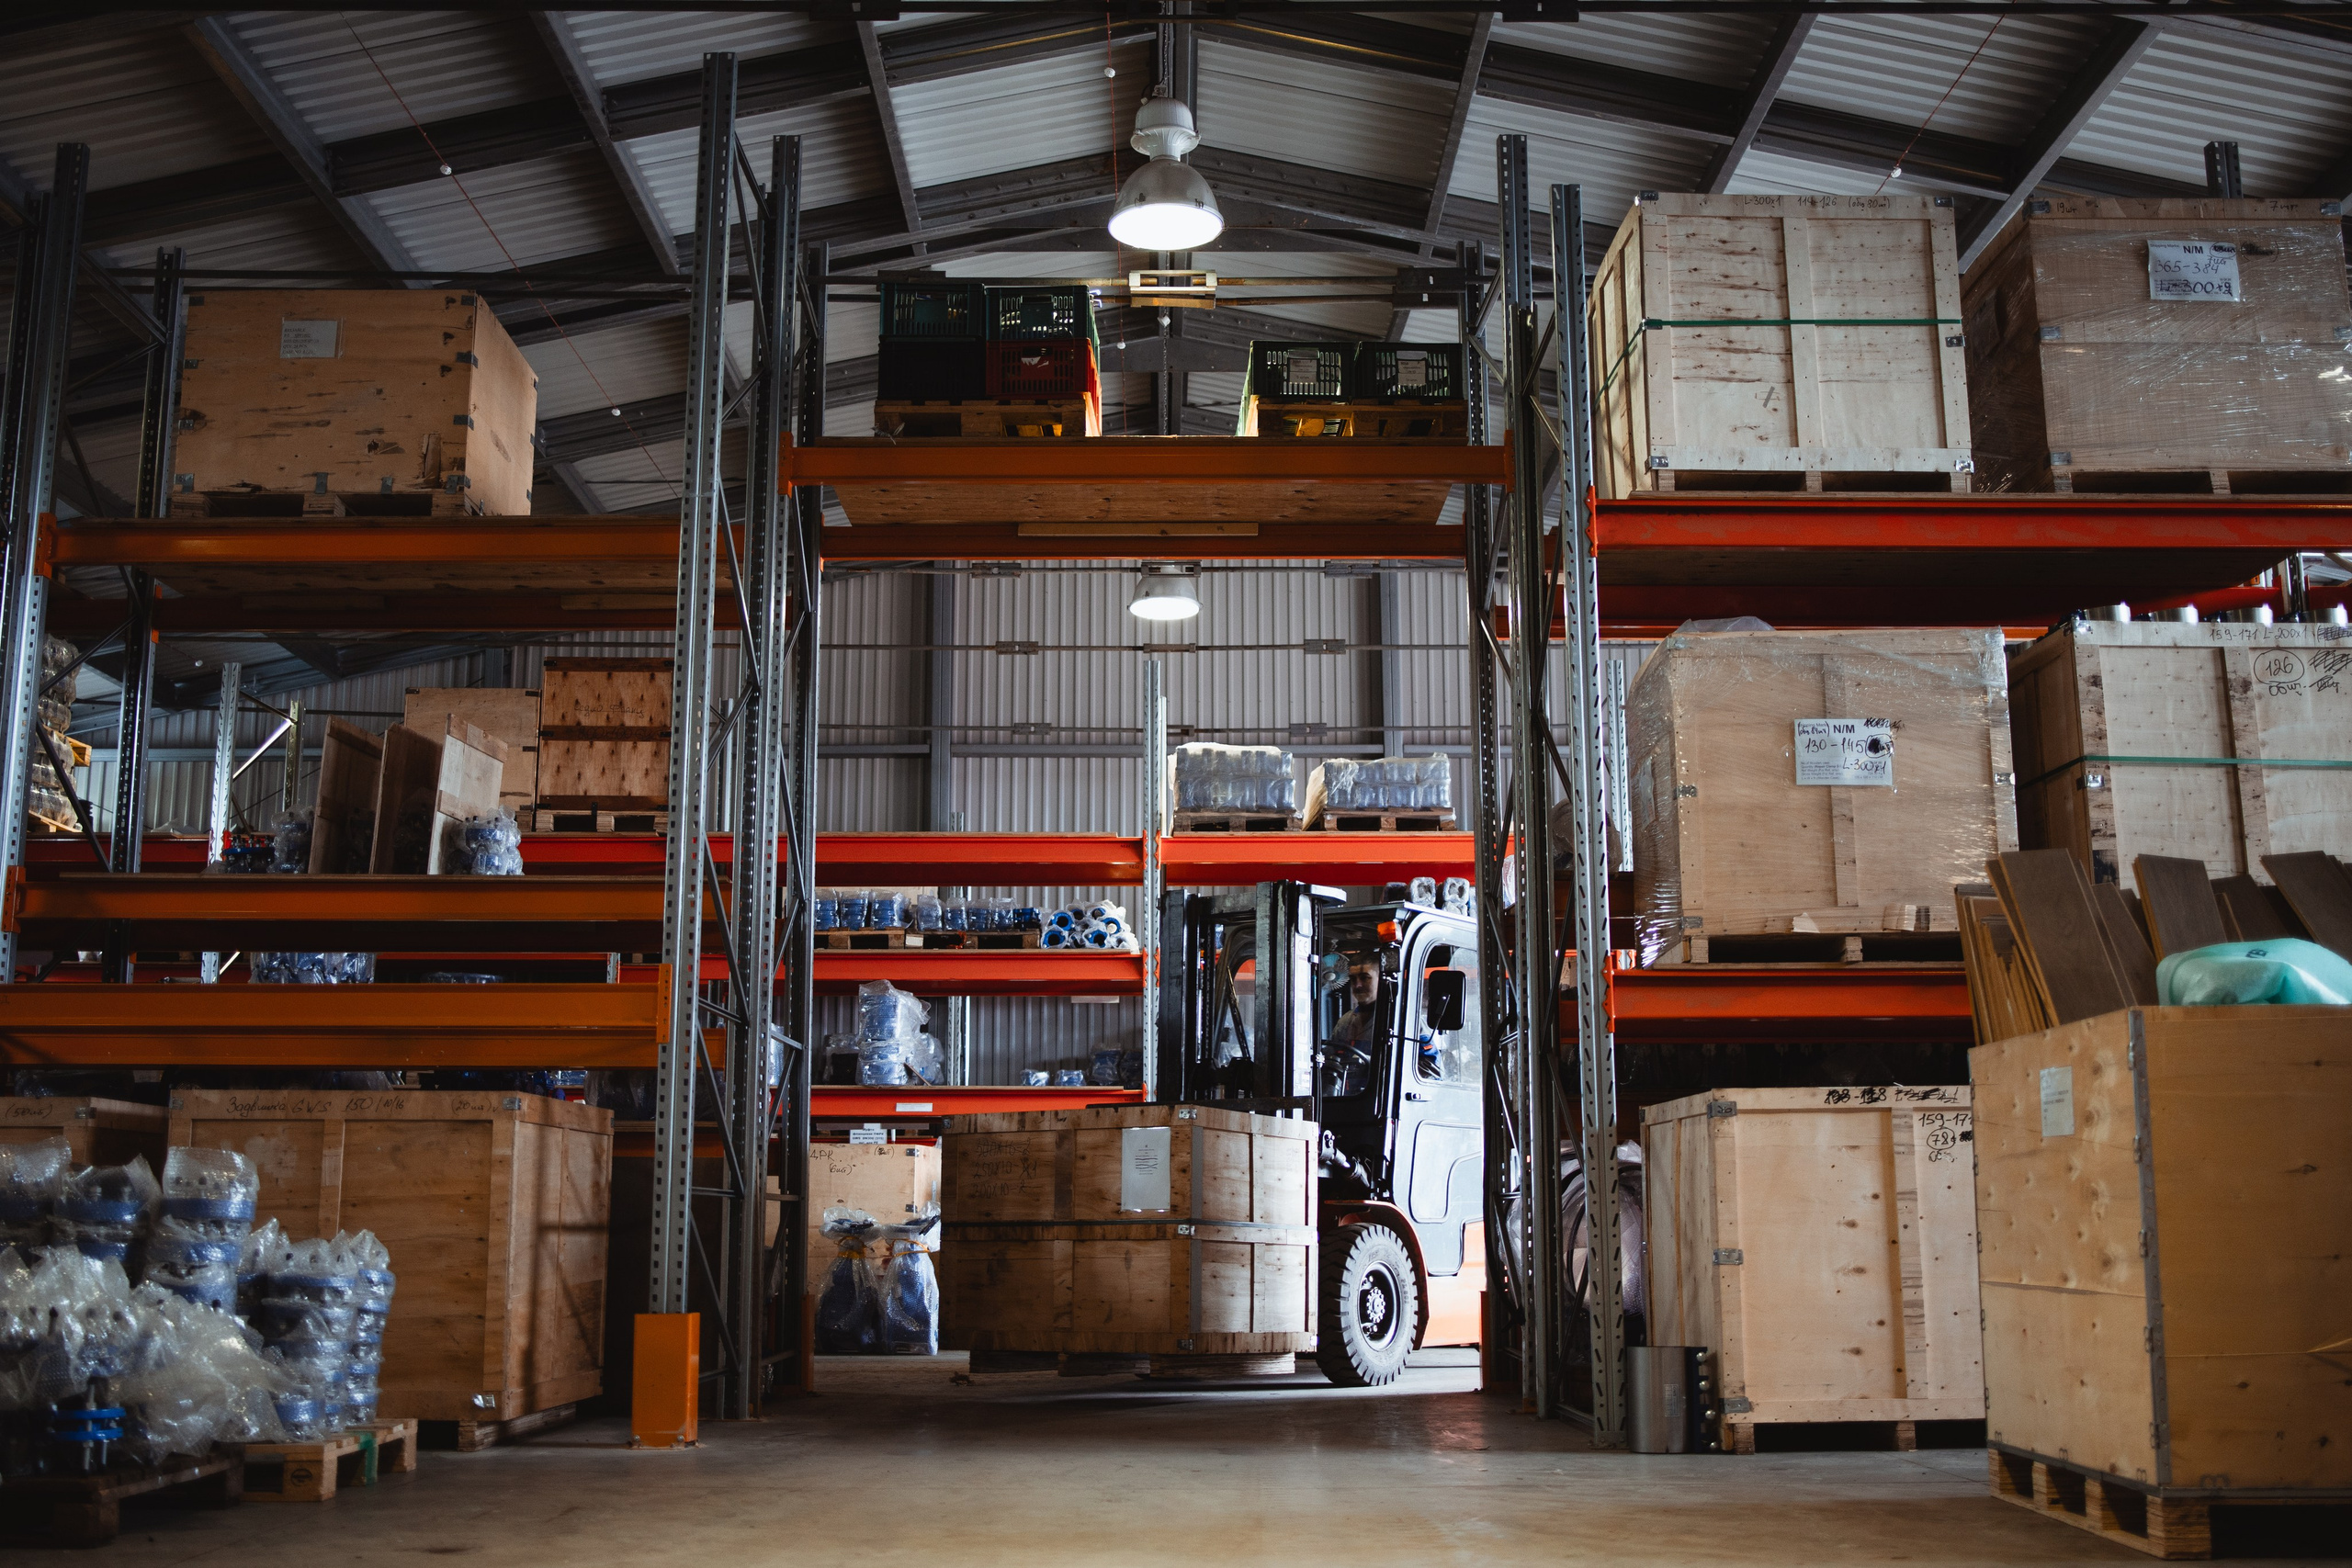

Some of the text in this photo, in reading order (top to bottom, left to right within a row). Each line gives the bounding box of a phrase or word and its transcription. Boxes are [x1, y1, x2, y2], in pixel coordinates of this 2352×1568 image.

[2183, 245, 2203, 254] N/M
[2209, 627, 2258, 642] 159-171
[2265, 656, 2294, 677] 126
[1833, 724, 1855, 734] N/M
[1931, 1132, 1950, 1145] 78
